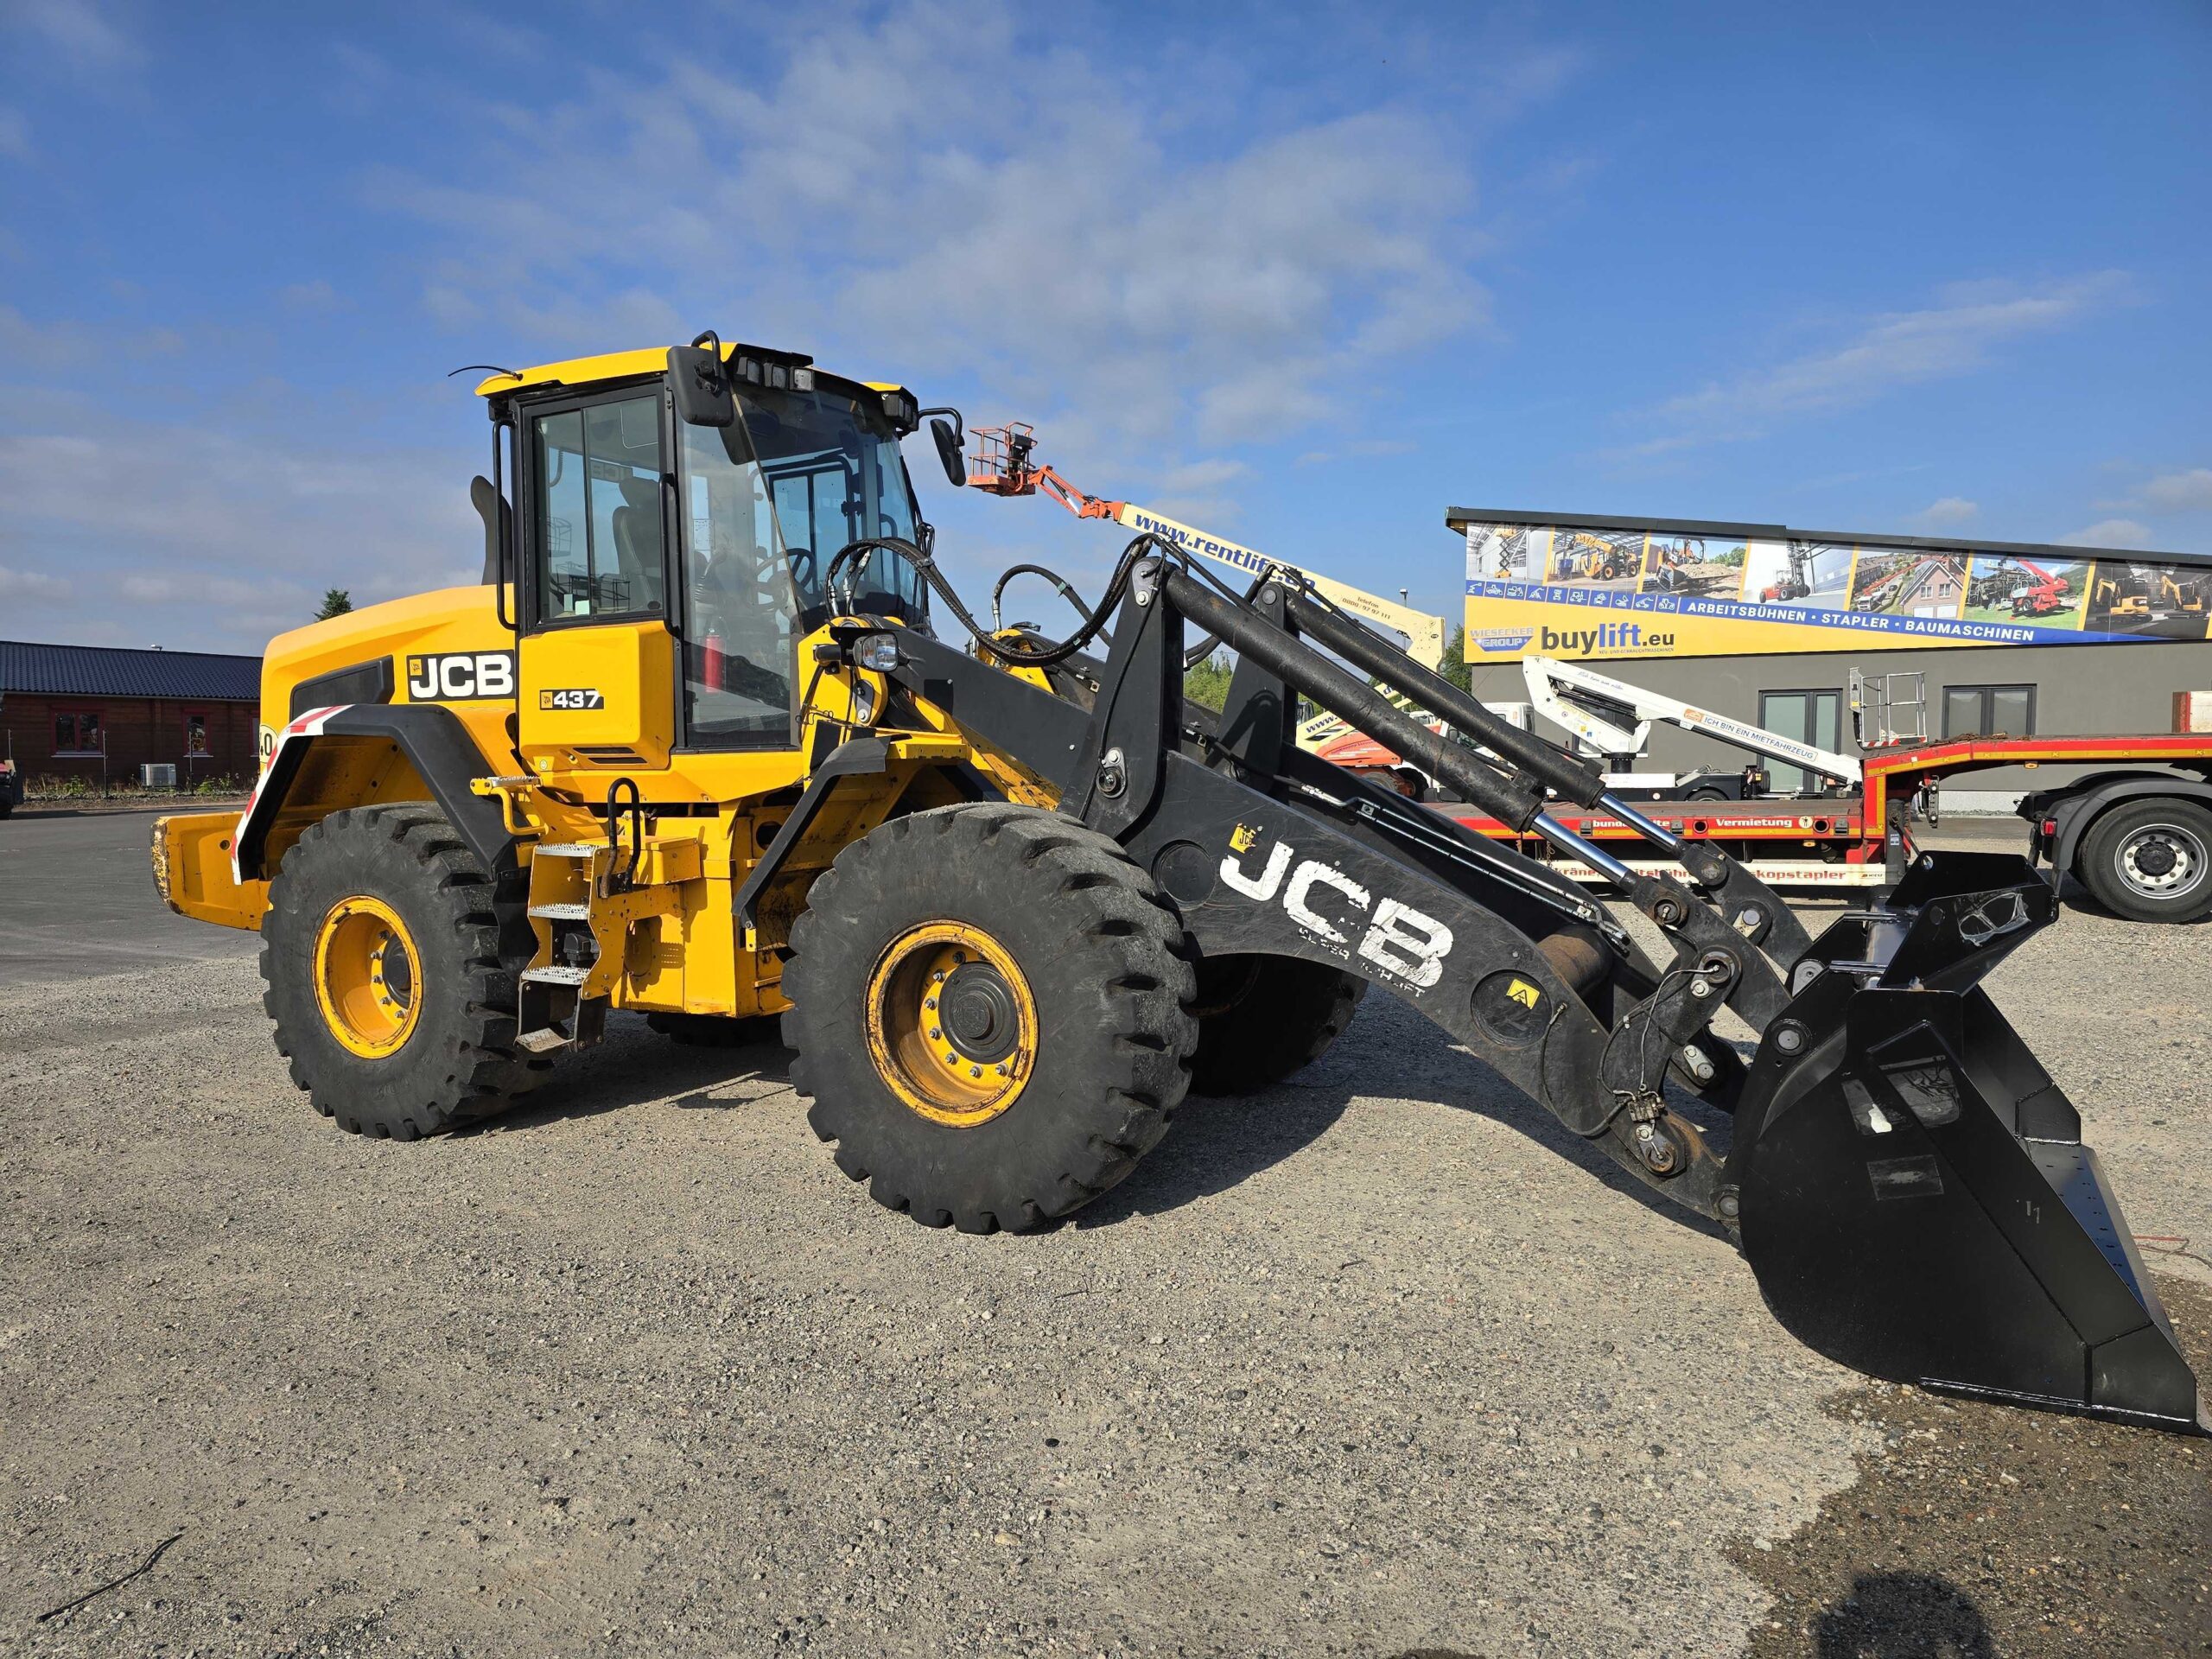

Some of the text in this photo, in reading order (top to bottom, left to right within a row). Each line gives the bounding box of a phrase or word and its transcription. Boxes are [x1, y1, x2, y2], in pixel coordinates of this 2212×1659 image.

[1470, 627, 1534, 637] WIESECKER
[1688, 602, 2034, 641] ARBEITSBÜHNEN STAPLER BAUMASCHINEN
[1482, 638, 1523, 647] GROUP
[1541, 622, 1675, 655] buylift.eu
[410, 654, 513, 698] JCB
[554, 690, 599, 709] 437
[1704, 716, 1814, 760] ICH BIN EIN MIETFAHRZEUG
[1716, 818, 1793, 828] Vermietung
[1219, 841, 1453, 988] JCB
